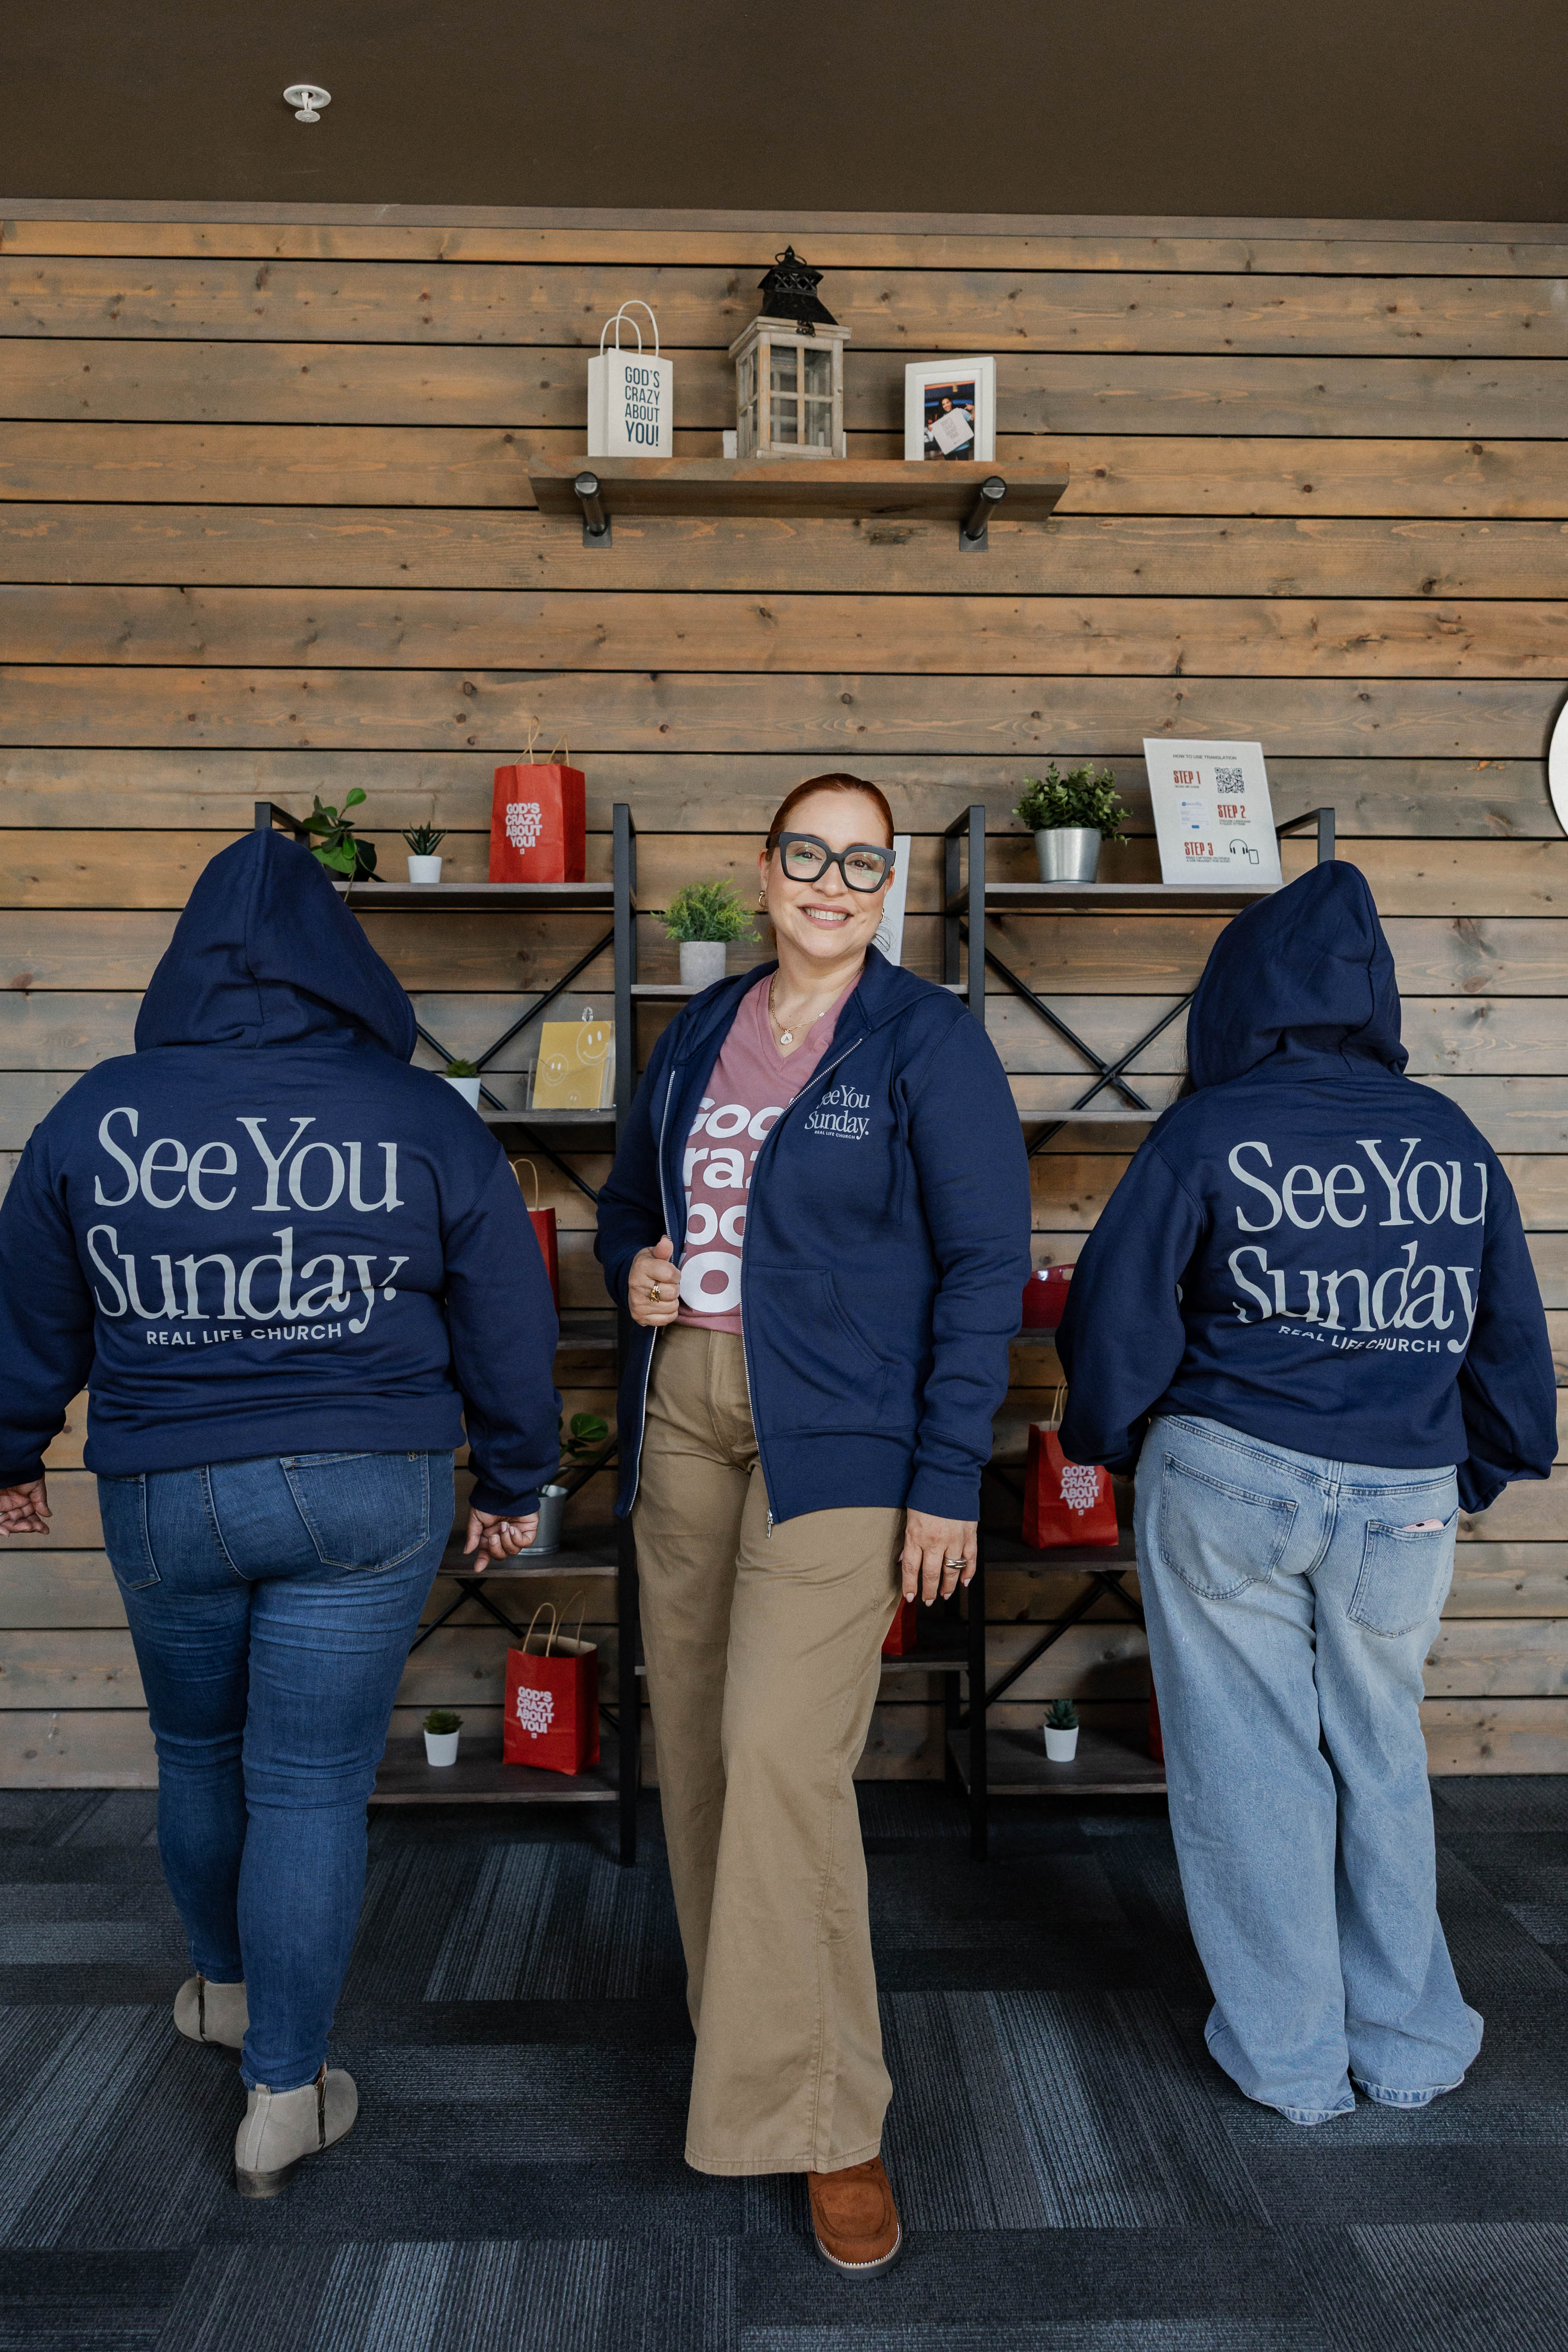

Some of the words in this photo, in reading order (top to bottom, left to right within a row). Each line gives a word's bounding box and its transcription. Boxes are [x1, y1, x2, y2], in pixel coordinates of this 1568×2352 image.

[625, 366, 660, 388] GOD'S
[625, 385, 660, 405] CRAZY
[625, 403, 660, 423] ABOUT
[625, 421, 659, 447] YOU!
[1173, 771, 1193, 784] STEP
[1196, 771, 1201, 784] 1
[506, 802, 540, 815] GOD'S
[1217, 804, 1238, 818] STEP
[1240, 805, 1246, 818] 2
[505, 813, 542, 826] CRAZY
[506, 824, 543, 837] ABOUT
[510, 836, 536, 848] YOU!
[1184, 842, 1205, 855] STEP
[1207, 842, 1214, 856] 3
[804, 1110, 870, 1140] Sunday.
[88, 1224, 410, 1334] Sunday.
[1228, 1240, 1481, 1354] Sunday
[147, 1331, 196, 1345] REAL
[203, 1328, 244, 1343] LIFE
[250, 1322, 342, 1340] CHURCH
[1278, 1325, 1325, 1342] REAL
[1332, 1335, 1366, 1350] LIFE
[1365, 1338, 1440, 1353] CHURCH
[1062, 1465, 1095, 1477] GOD'S
[1061, 1475, 1097, 1488] CRAZY
[1060, 1486, 1099, 1499] ABOUT
[1066, 1497, 1094, 1509] YOU!
[518, 1686, 552, 1703] GOD'S
[517, 1696, 554, 1713] CRAZY
[516, 1707, 554, 1723] ABOUT
[520, 1717, 547, 1733] YOU!
